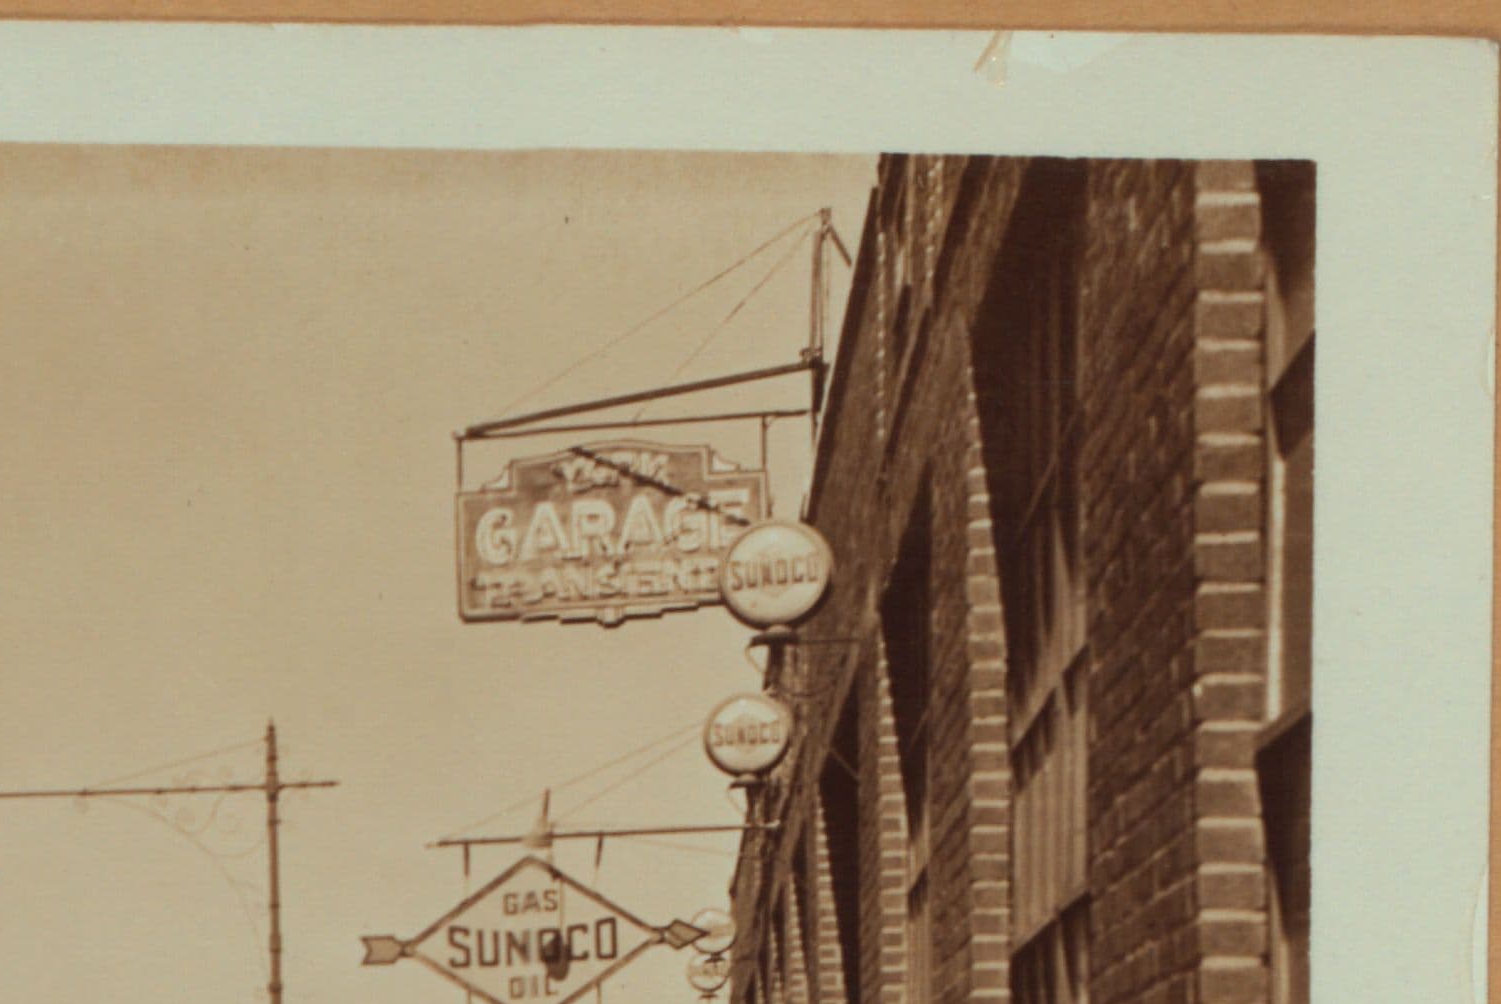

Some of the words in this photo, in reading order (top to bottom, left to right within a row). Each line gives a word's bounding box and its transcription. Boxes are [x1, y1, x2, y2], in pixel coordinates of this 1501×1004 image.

[475, 488, 749, 565] GARAGE
[730, 556, 819, 592] SUNOCO
[713, 721, 781, 748] SUNOCO
[502, 889, 559, 916] GAS
[447, 917, 618, 969] SUNOCO
[509, 974, 559, 1000] OIL
